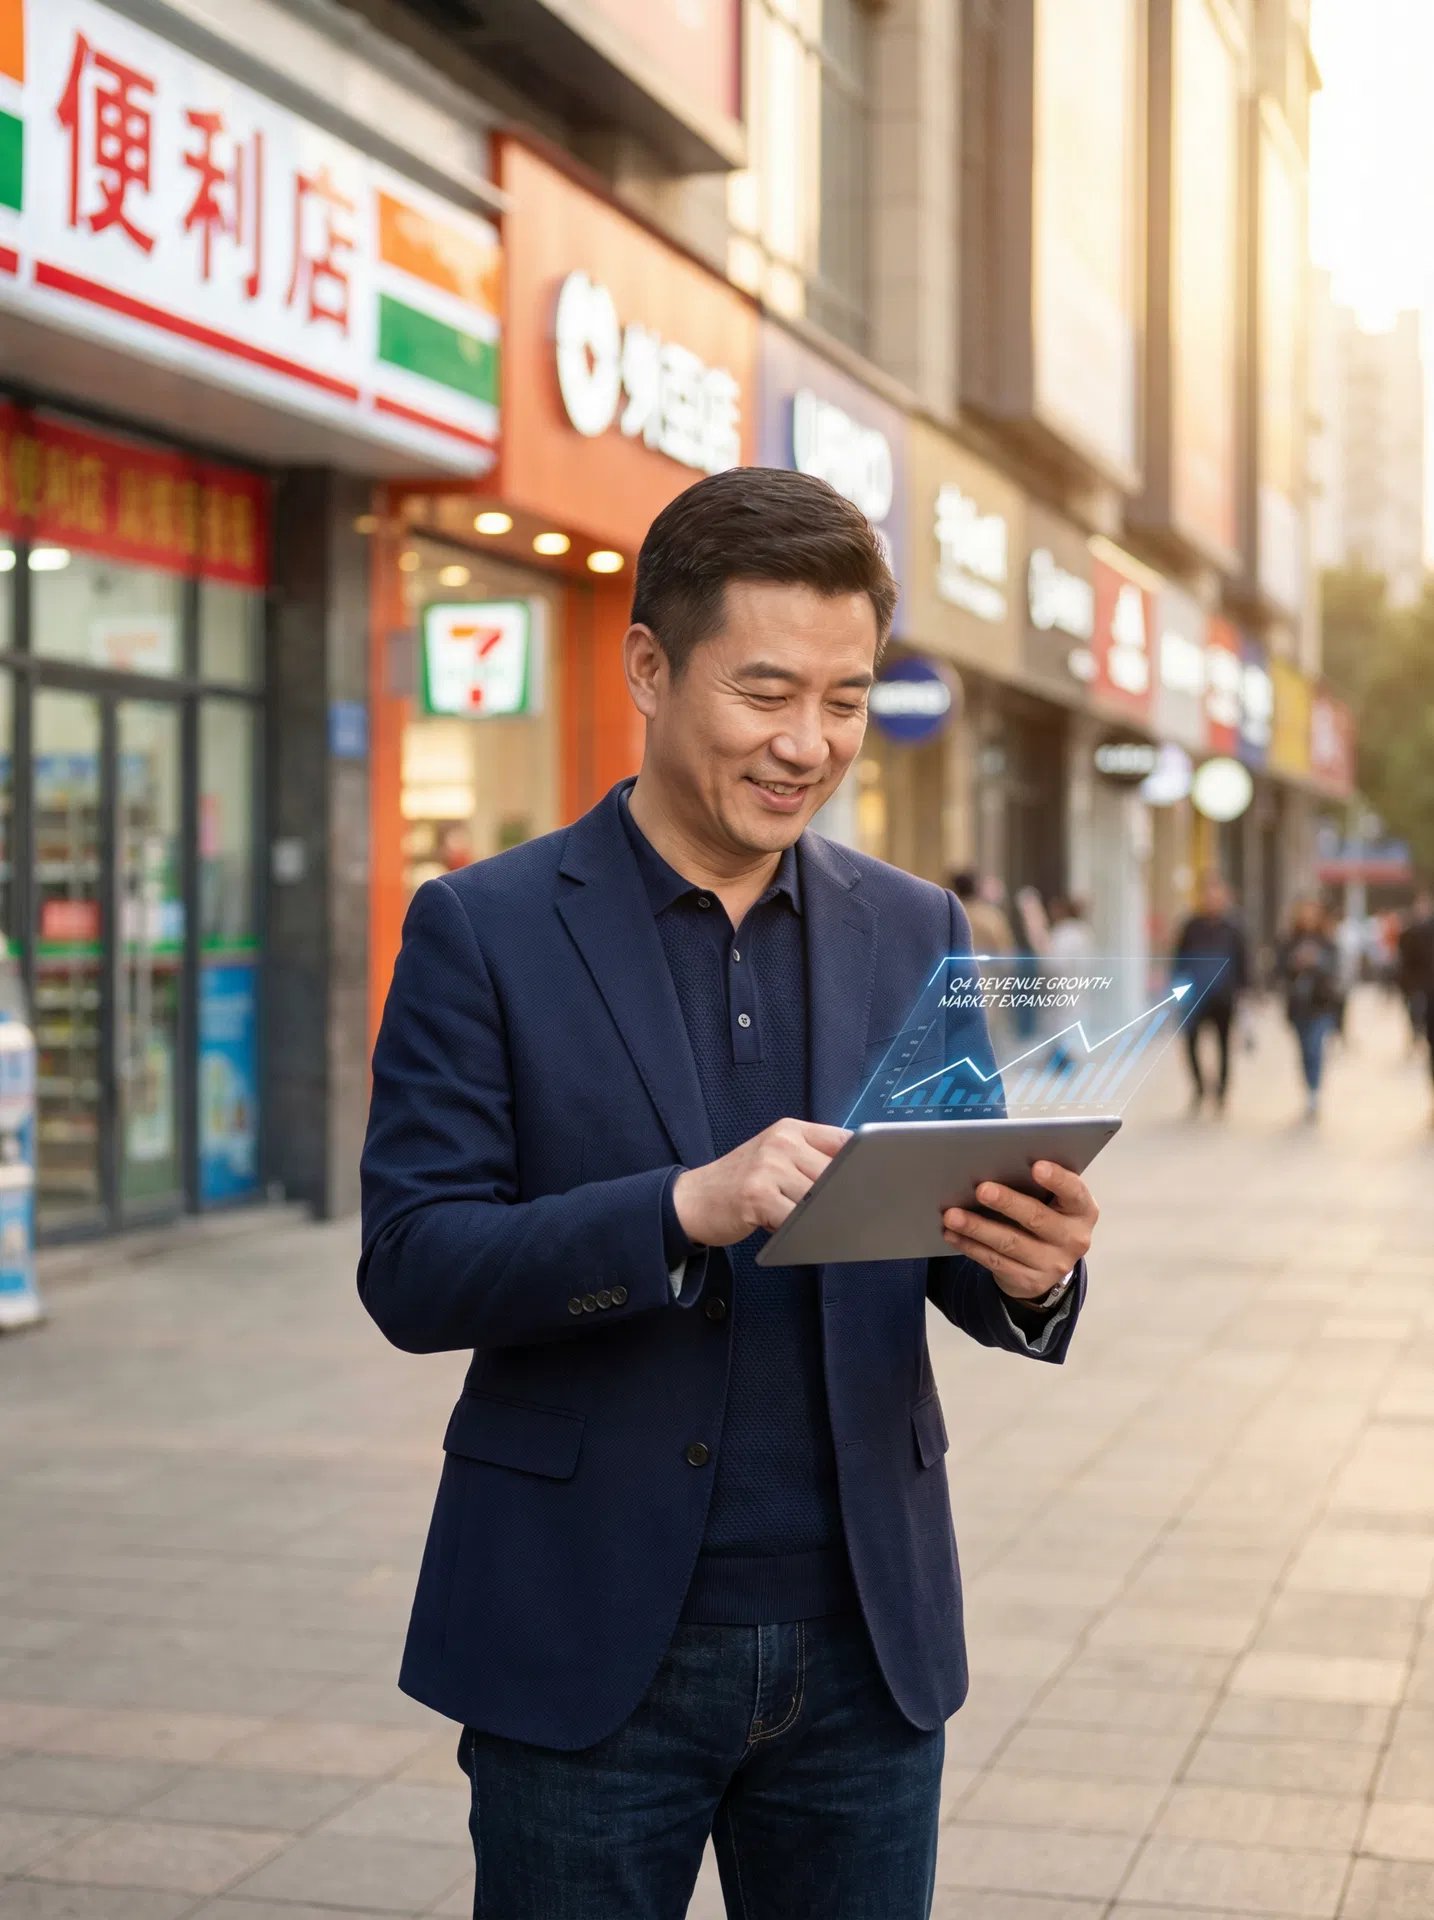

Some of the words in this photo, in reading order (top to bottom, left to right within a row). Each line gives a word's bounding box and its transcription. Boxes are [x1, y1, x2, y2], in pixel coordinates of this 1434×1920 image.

[56, 30, 356, 336] 便利店
[949, 977, 973, 993] Q4
[974, 977, 1045, 990] REVENUE
[1046, 977, 1113, 990] GROWTH
[937, 994, 1000, 1008] MARKET
[998, 994, 1079, 1008] EXPANSION
